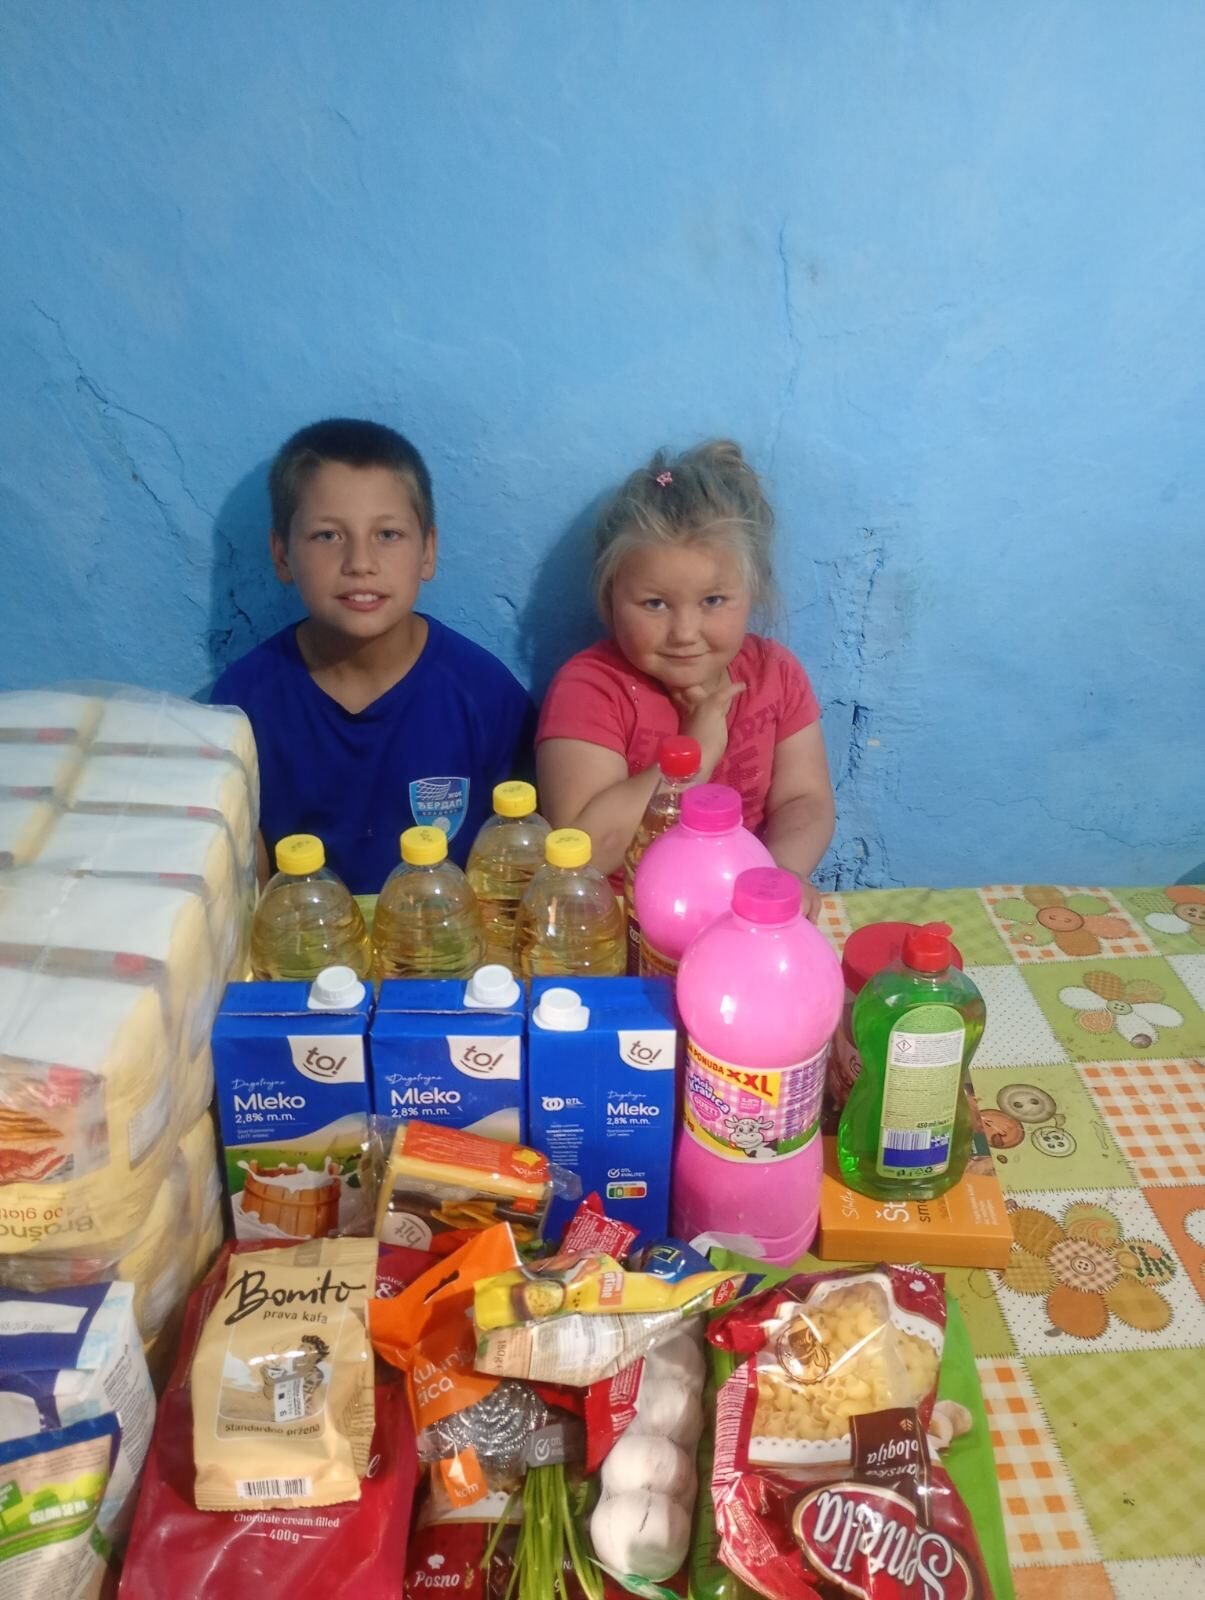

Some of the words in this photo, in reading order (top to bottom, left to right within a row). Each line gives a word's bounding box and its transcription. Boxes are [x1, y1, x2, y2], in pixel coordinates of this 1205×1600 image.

[306, 1047, 347, 1074] to!
[463, 1045, 504, 1071] to!
[629, 1040, 662, 1064] to!
[727, 1068, 773, 1097] XXL
[233, 1092, 306, 1112] Mleko
[391, 1087, 461, 1107] Mleko
[235, 1113, 264, 1124] 2,8%
[267, 1113, 296, 1121] m.m.
[391, 1107, 419, 1118] 2,8%
[422, 1107, 450, 1116] m.m.
[607, 1102, 660, 1116] Mleko
[606, 1117, 628, 1126] 2,8%
[0, 1206, 38, 1222] glat
[875, 1201, 910, 1223] Št
[224, 1269, 367, 1326] Bonito
[263, 1310, 298, 1321] prava
[302, 1310, 328, 1324] kafa
[866, 1439, 919, 1466] ologija
[233, 1512, 281, 1525] Chocolate
[282, 1516, 313, 1526] cream
[315, 1516, 340, 1528] filled
[414, 1570, 460, 1588] Posno
